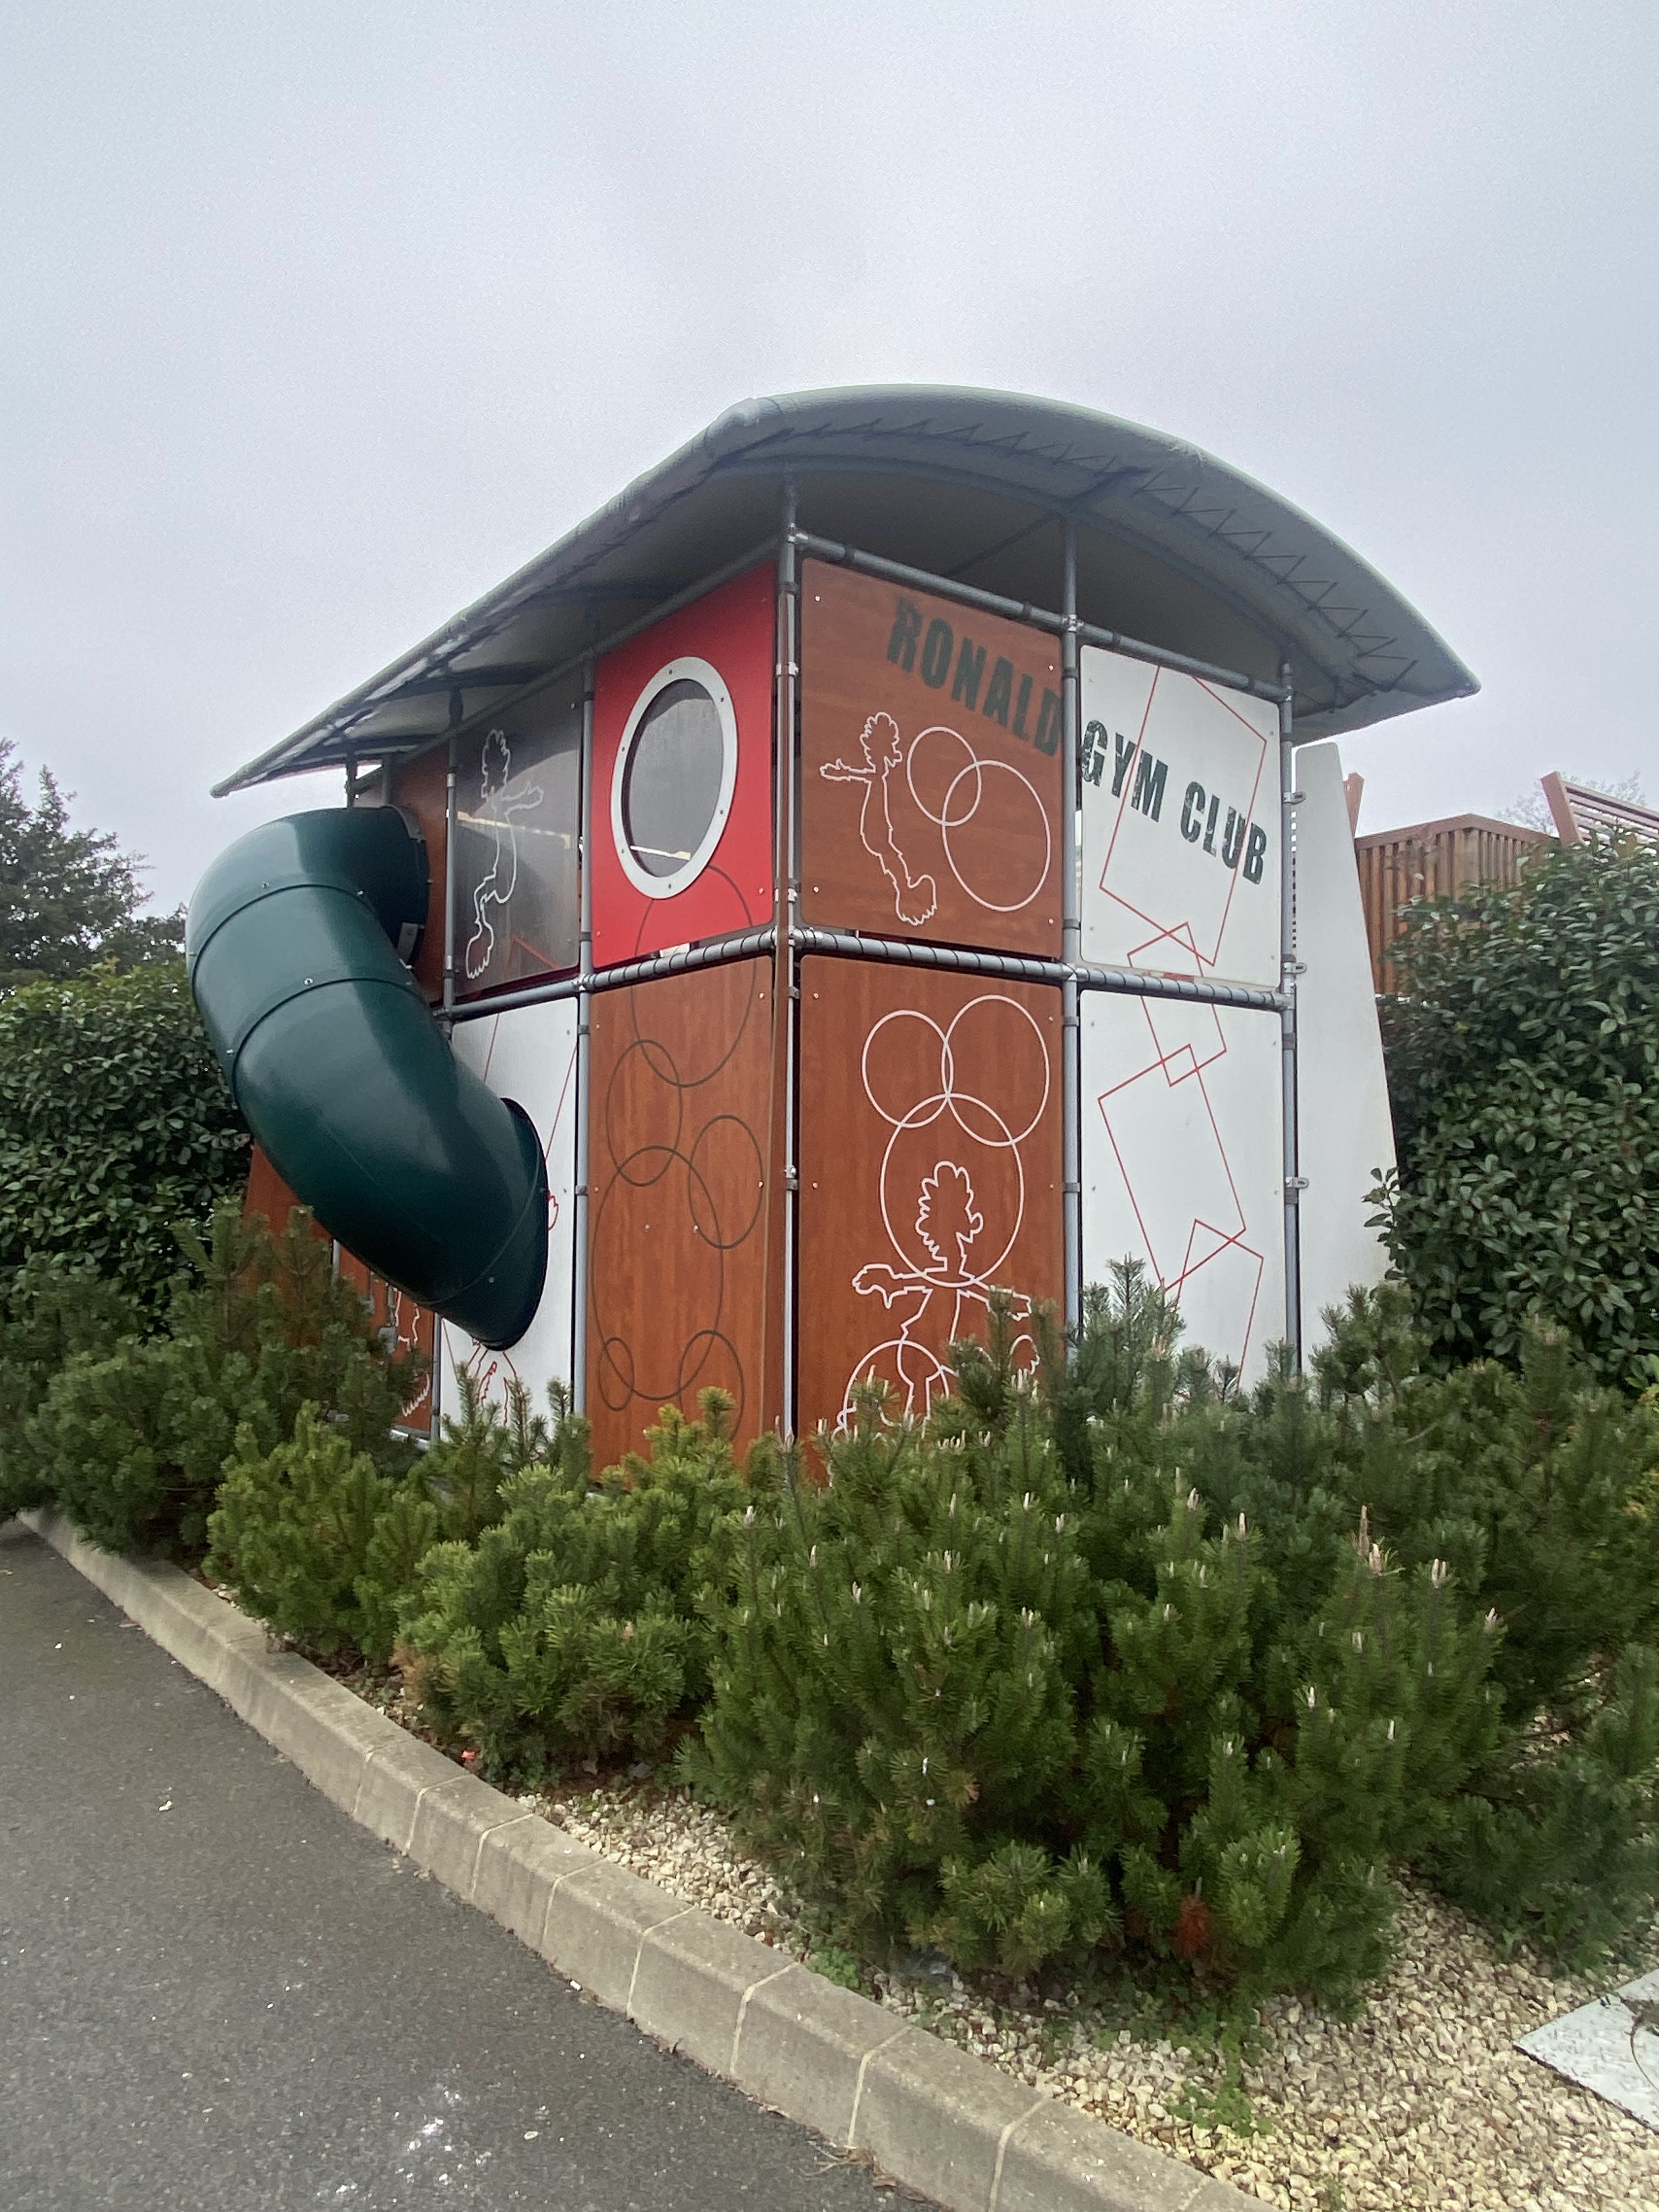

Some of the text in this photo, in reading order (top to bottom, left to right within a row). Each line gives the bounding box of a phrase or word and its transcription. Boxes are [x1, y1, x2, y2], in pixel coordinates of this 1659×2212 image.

[888, 596, 1267, 884] RONALD GYM CLUB
